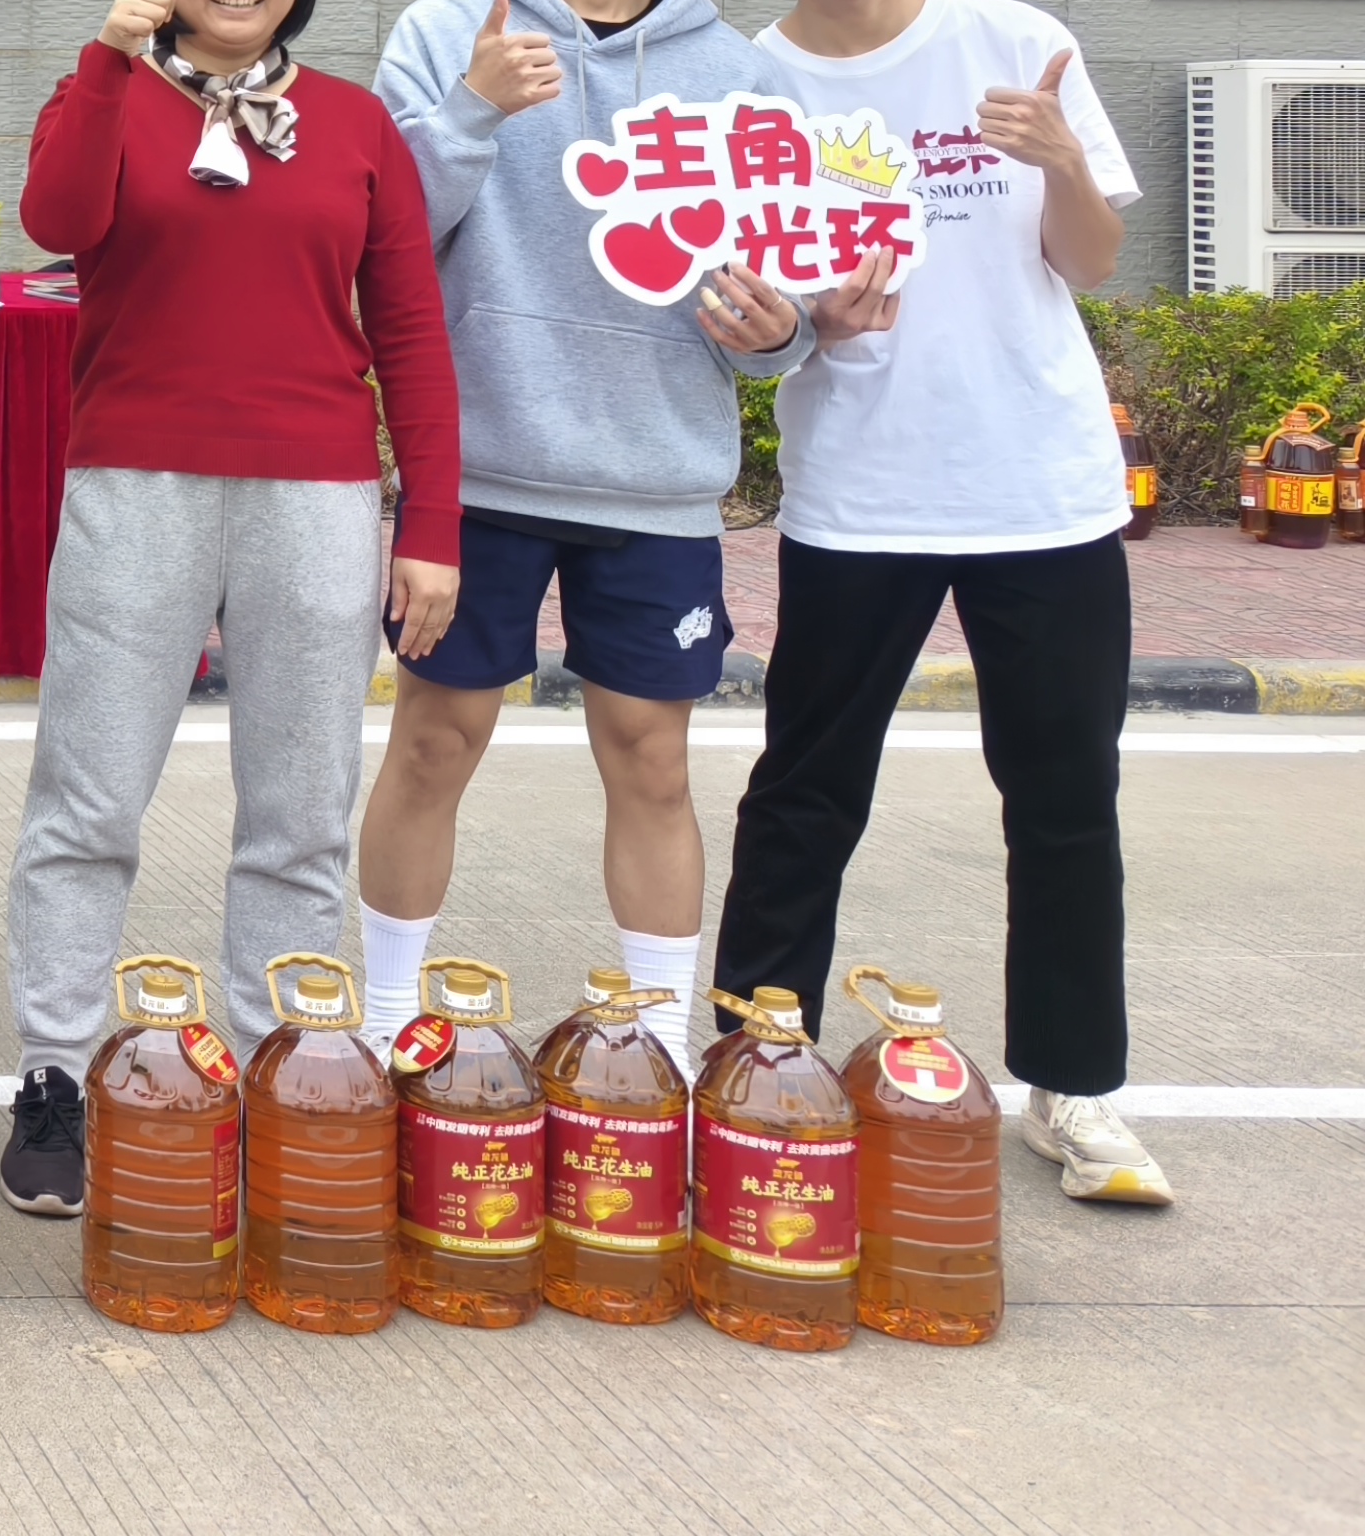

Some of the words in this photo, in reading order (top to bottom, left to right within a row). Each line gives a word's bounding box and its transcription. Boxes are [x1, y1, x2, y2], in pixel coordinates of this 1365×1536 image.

[627, 104, 811, 191] 主角
[923, 148, 951, 158] ENJOY
[953, 144, 988, 155] TODAY
[735, 201, 914, 281] 光环
[452, 1161, 533, 1182] 纯正花生油
[563, 1149, 653, 1177] 纯正花生油
[741, 1175, 835, 1201] 纯正花生油
